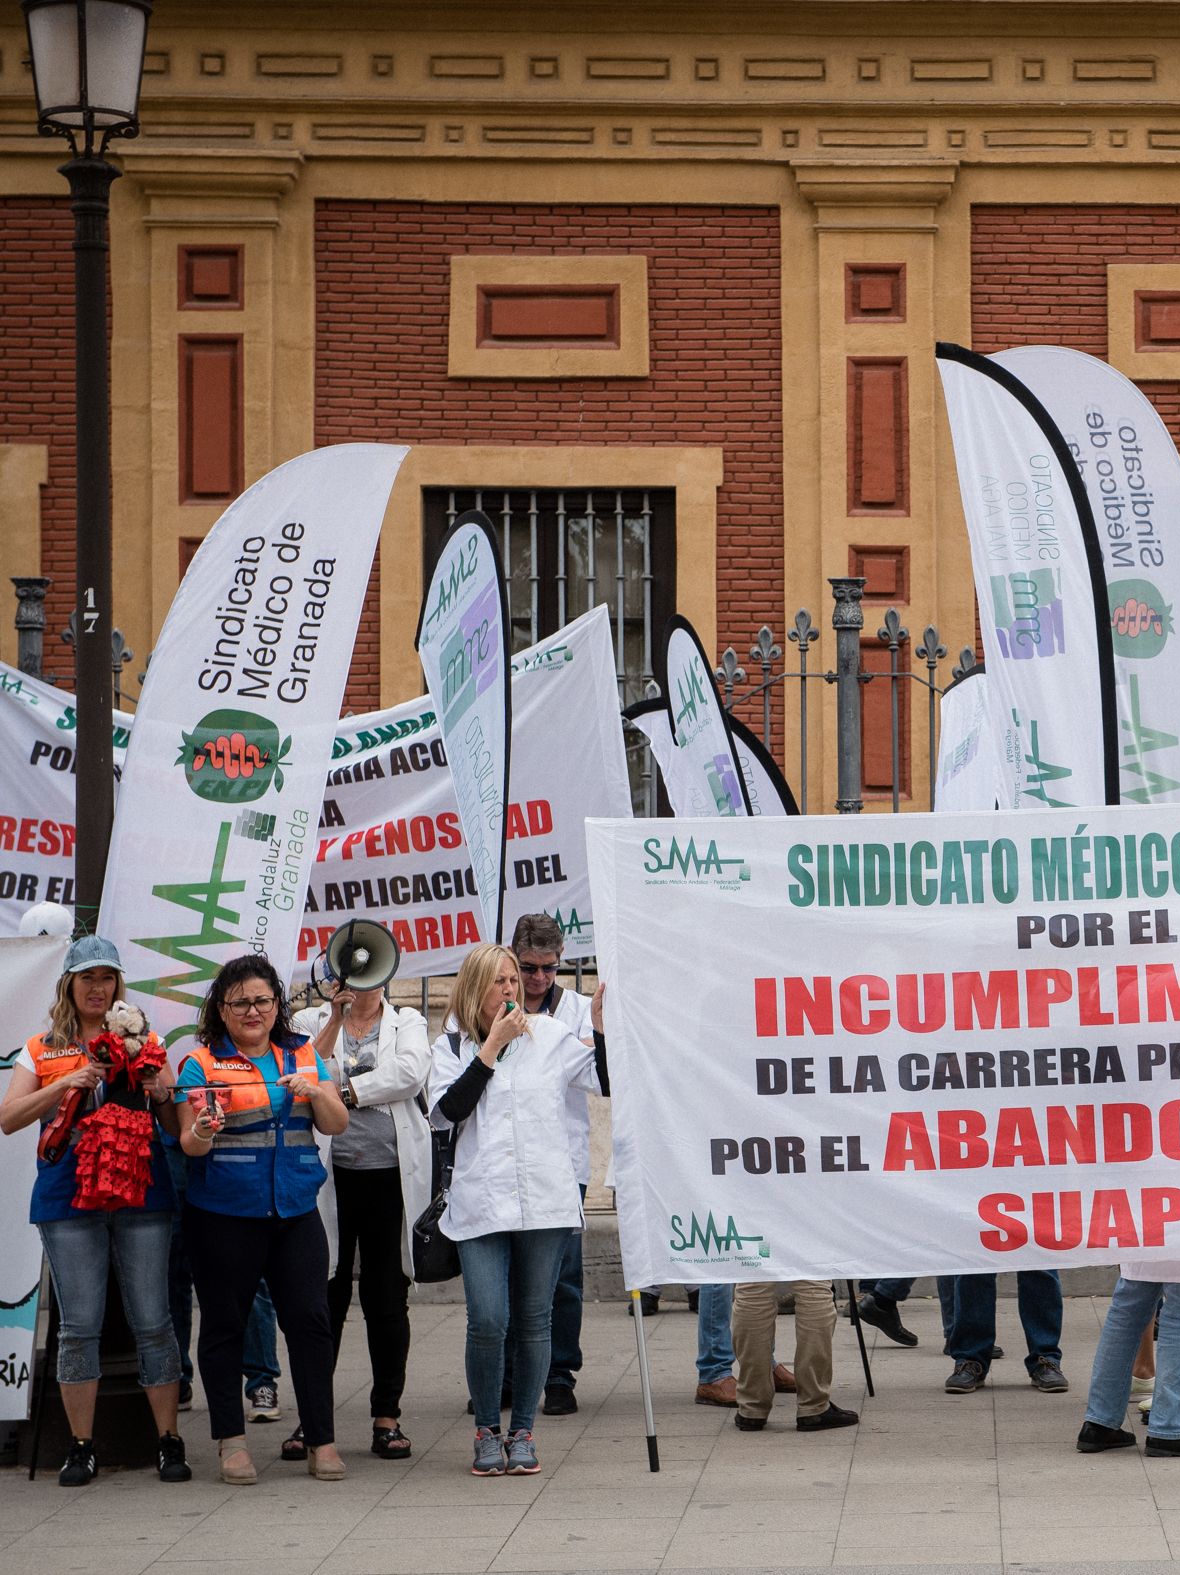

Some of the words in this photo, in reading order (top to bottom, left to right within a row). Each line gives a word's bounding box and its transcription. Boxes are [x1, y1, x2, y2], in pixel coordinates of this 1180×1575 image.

[197, 535, 266, 693] Sindicato
[236, 575, 293, 699] Médico
[271, 522, 305, 564] de
[276, 557, 337, 704] Granada
[29, 740, 76, 775] PO
[255, 836, 283, 912] Andaluz
[272, 807, 310, 913] Granada
[513, 853, 568, 889] DEL
[643, 835, 745, 879] SMA
[786, 838, 1019, 907] SINDICATO
[1016, 912, 1115, 950] POR
[1128, 908, 1179, 946] EL
[43, 1047, 84, 1060] MEDICO
[212, 1061, 252, 1070] MEDICO
[756, 1057, 816, 1096] DE
[828, 1054, 887, 1094] LA
[898, 1045, 1126, 1092] CARRERA
[710, 1135, 807, 1176] POR
[820, 1135, 870, 1173] EL
[669, 1208, 764, 1257] SMA
